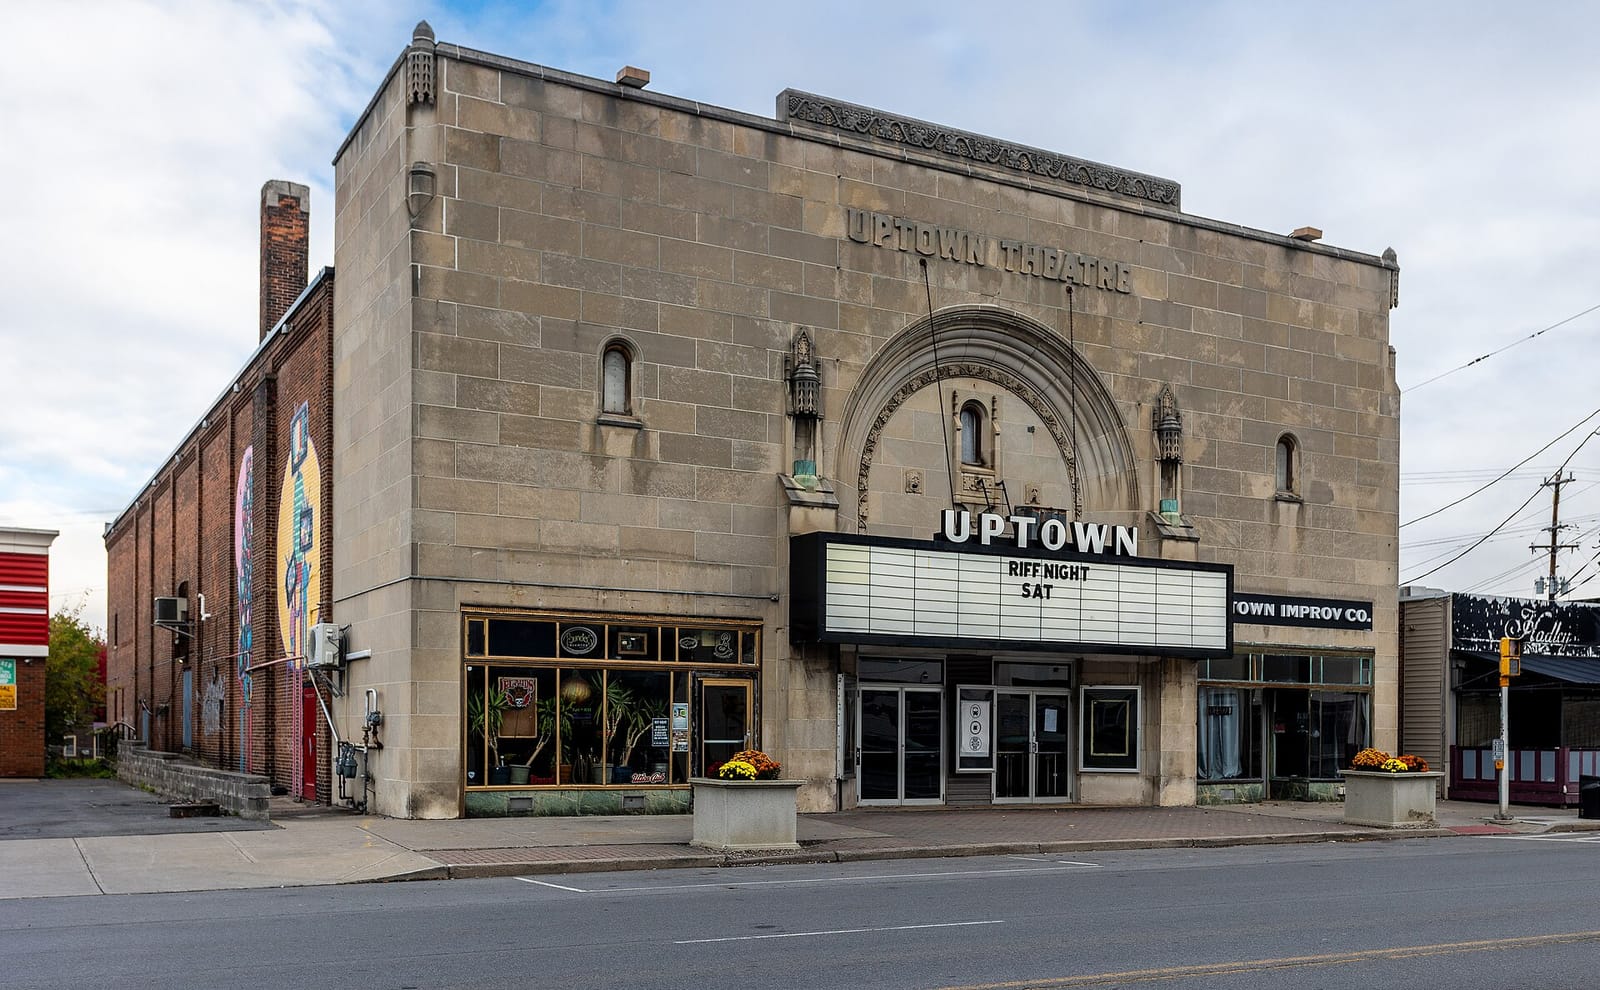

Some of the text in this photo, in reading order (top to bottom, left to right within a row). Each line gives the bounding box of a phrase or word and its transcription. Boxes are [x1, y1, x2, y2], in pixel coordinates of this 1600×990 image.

[848, 209, 1131, 294] UPTOWN THEATRE
[942, 509, 1138, 557] UPTOWN
[1008, 560, 1090, 582] RIFF NIGHT
[1021, 582, 1053, 599] SAT
[1280, 604, 1343, 620] IMPROV
[1344, 608, 1371, 622] CO.
